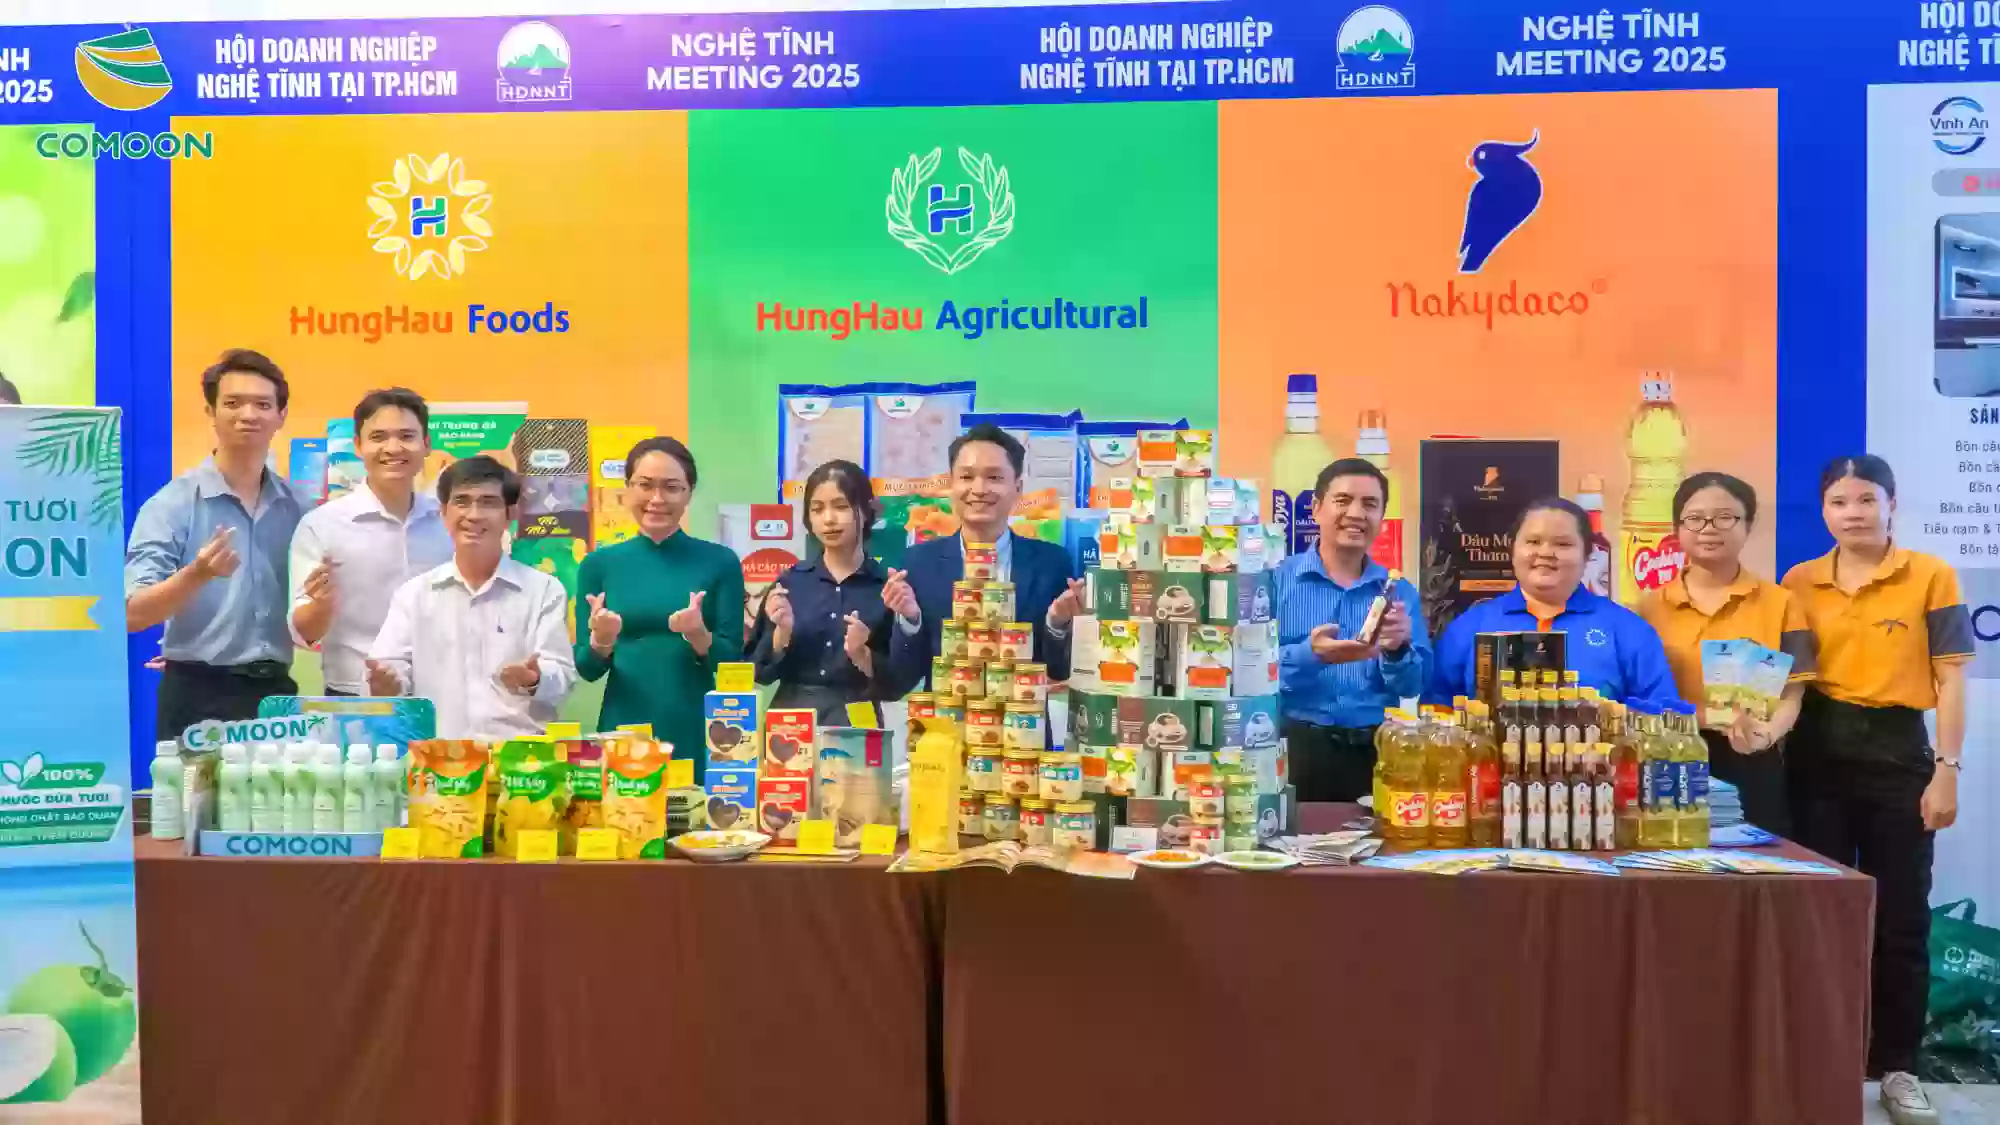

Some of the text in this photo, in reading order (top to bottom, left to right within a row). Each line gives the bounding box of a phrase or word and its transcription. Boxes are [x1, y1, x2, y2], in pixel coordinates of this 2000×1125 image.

[1040, 16, 1273, 58] HỘI DOANH NGHIỆP
[1523, 8, 1699, 45] NGHỆ TĨNH
[215, 32, 437, 69] HỘI DOANH NGHIỆP
[671, 26, 834, 62] NGHỆ TĨNH
[1899, 31, 1970, 71] NGHỆ
[1020, 56, 1295, 94] NGHỆ TĨNH TẠI TP.HCM
[1496, 46, 1726, 76] MEETING 2025
[0, 79, 53, 103] 025
[197, 68, 458, 103] NGHỆ TĨNH TẠI TP.HCM
[501, 84, 568, 99] HDNNT
[647, 63, 860, 91] MEETING 2025
[1341, 70, 1412, 88] HDNNT
[1968, 117, 1989, 130] An
[289, 302, 570, 343] HungHau Foods
[755, 297, 1148, 340] HungHau Agricultural
[5, 496, 77, 522] TƯƠI
[1983, 523, 1991, 534] &
[42, 768, 95, 782] 100%
[226, 835, 353, 856] COMOON
